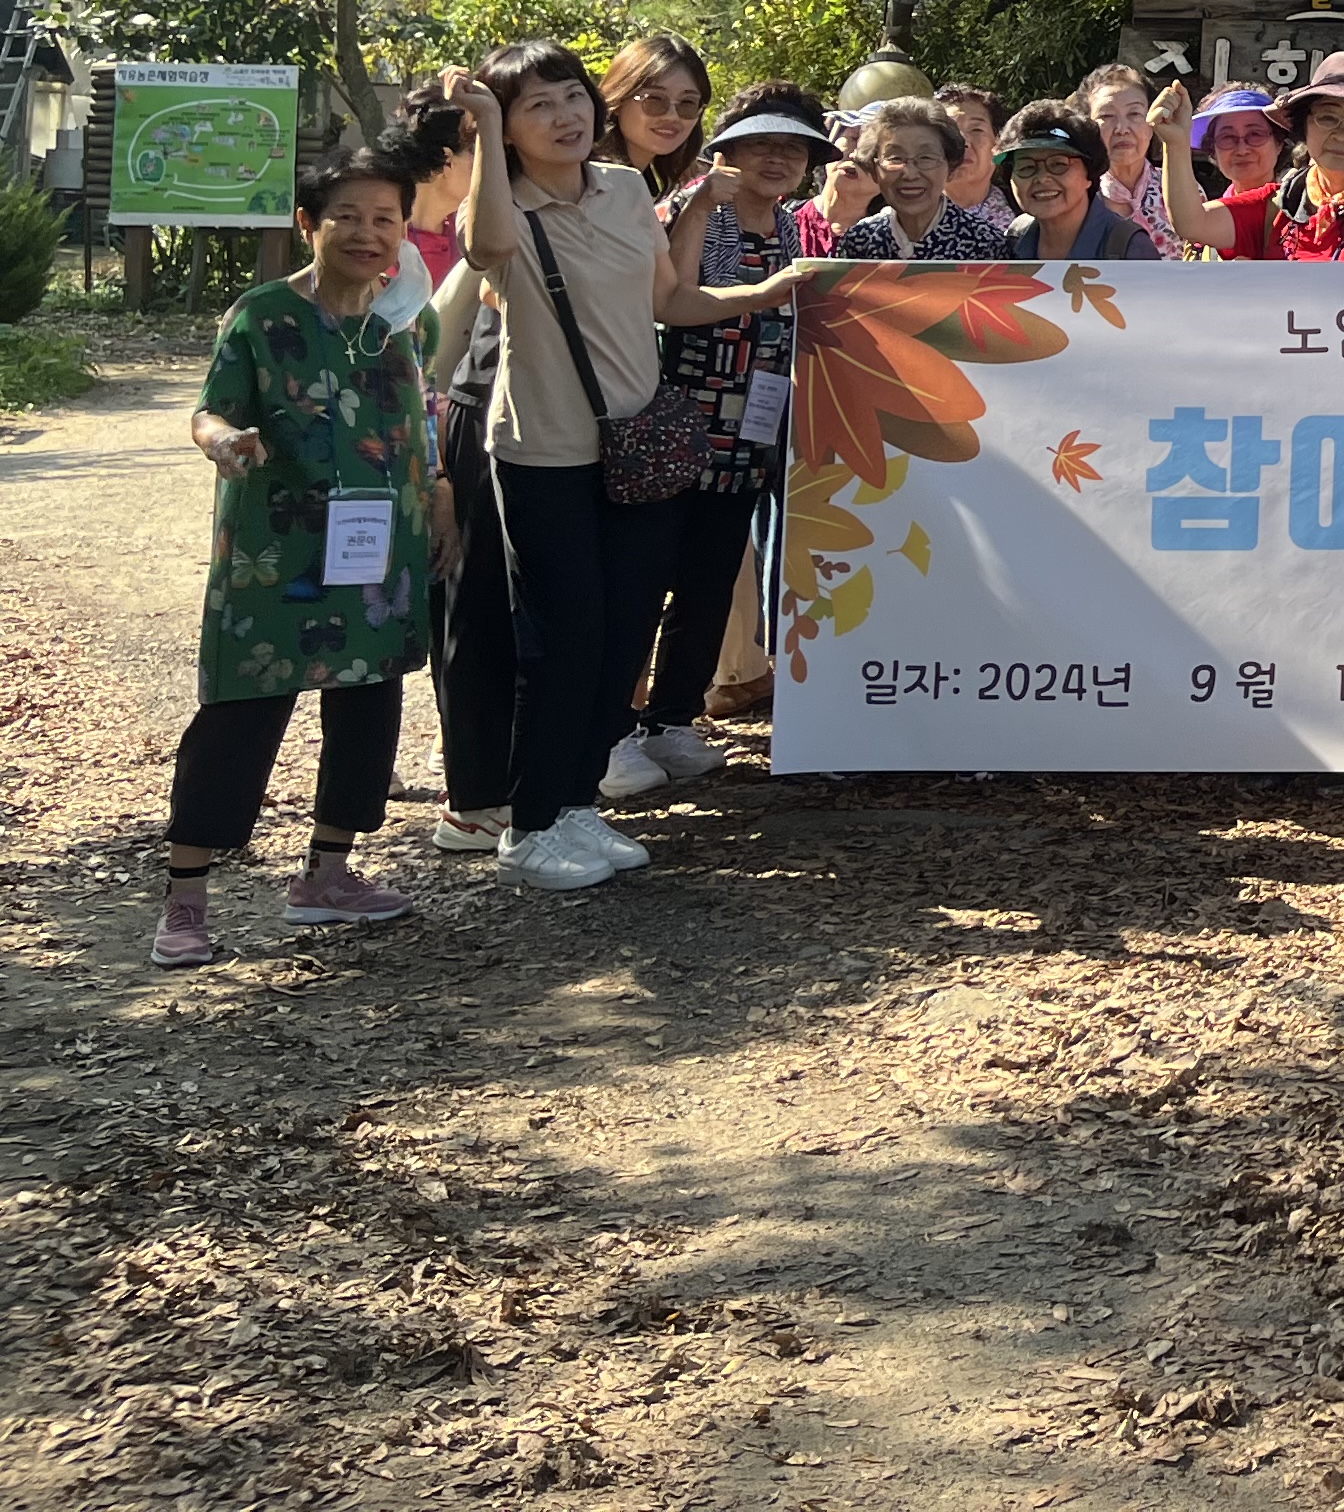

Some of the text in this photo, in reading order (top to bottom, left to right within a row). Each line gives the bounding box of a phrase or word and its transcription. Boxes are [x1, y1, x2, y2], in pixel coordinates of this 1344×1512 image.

[861, 659, 961, 705] 일자:
[977, 662, 1131, 707] 2024년
[1190, 664, 1217, 703] 9
[1235, 661, 1276, 708] 월
